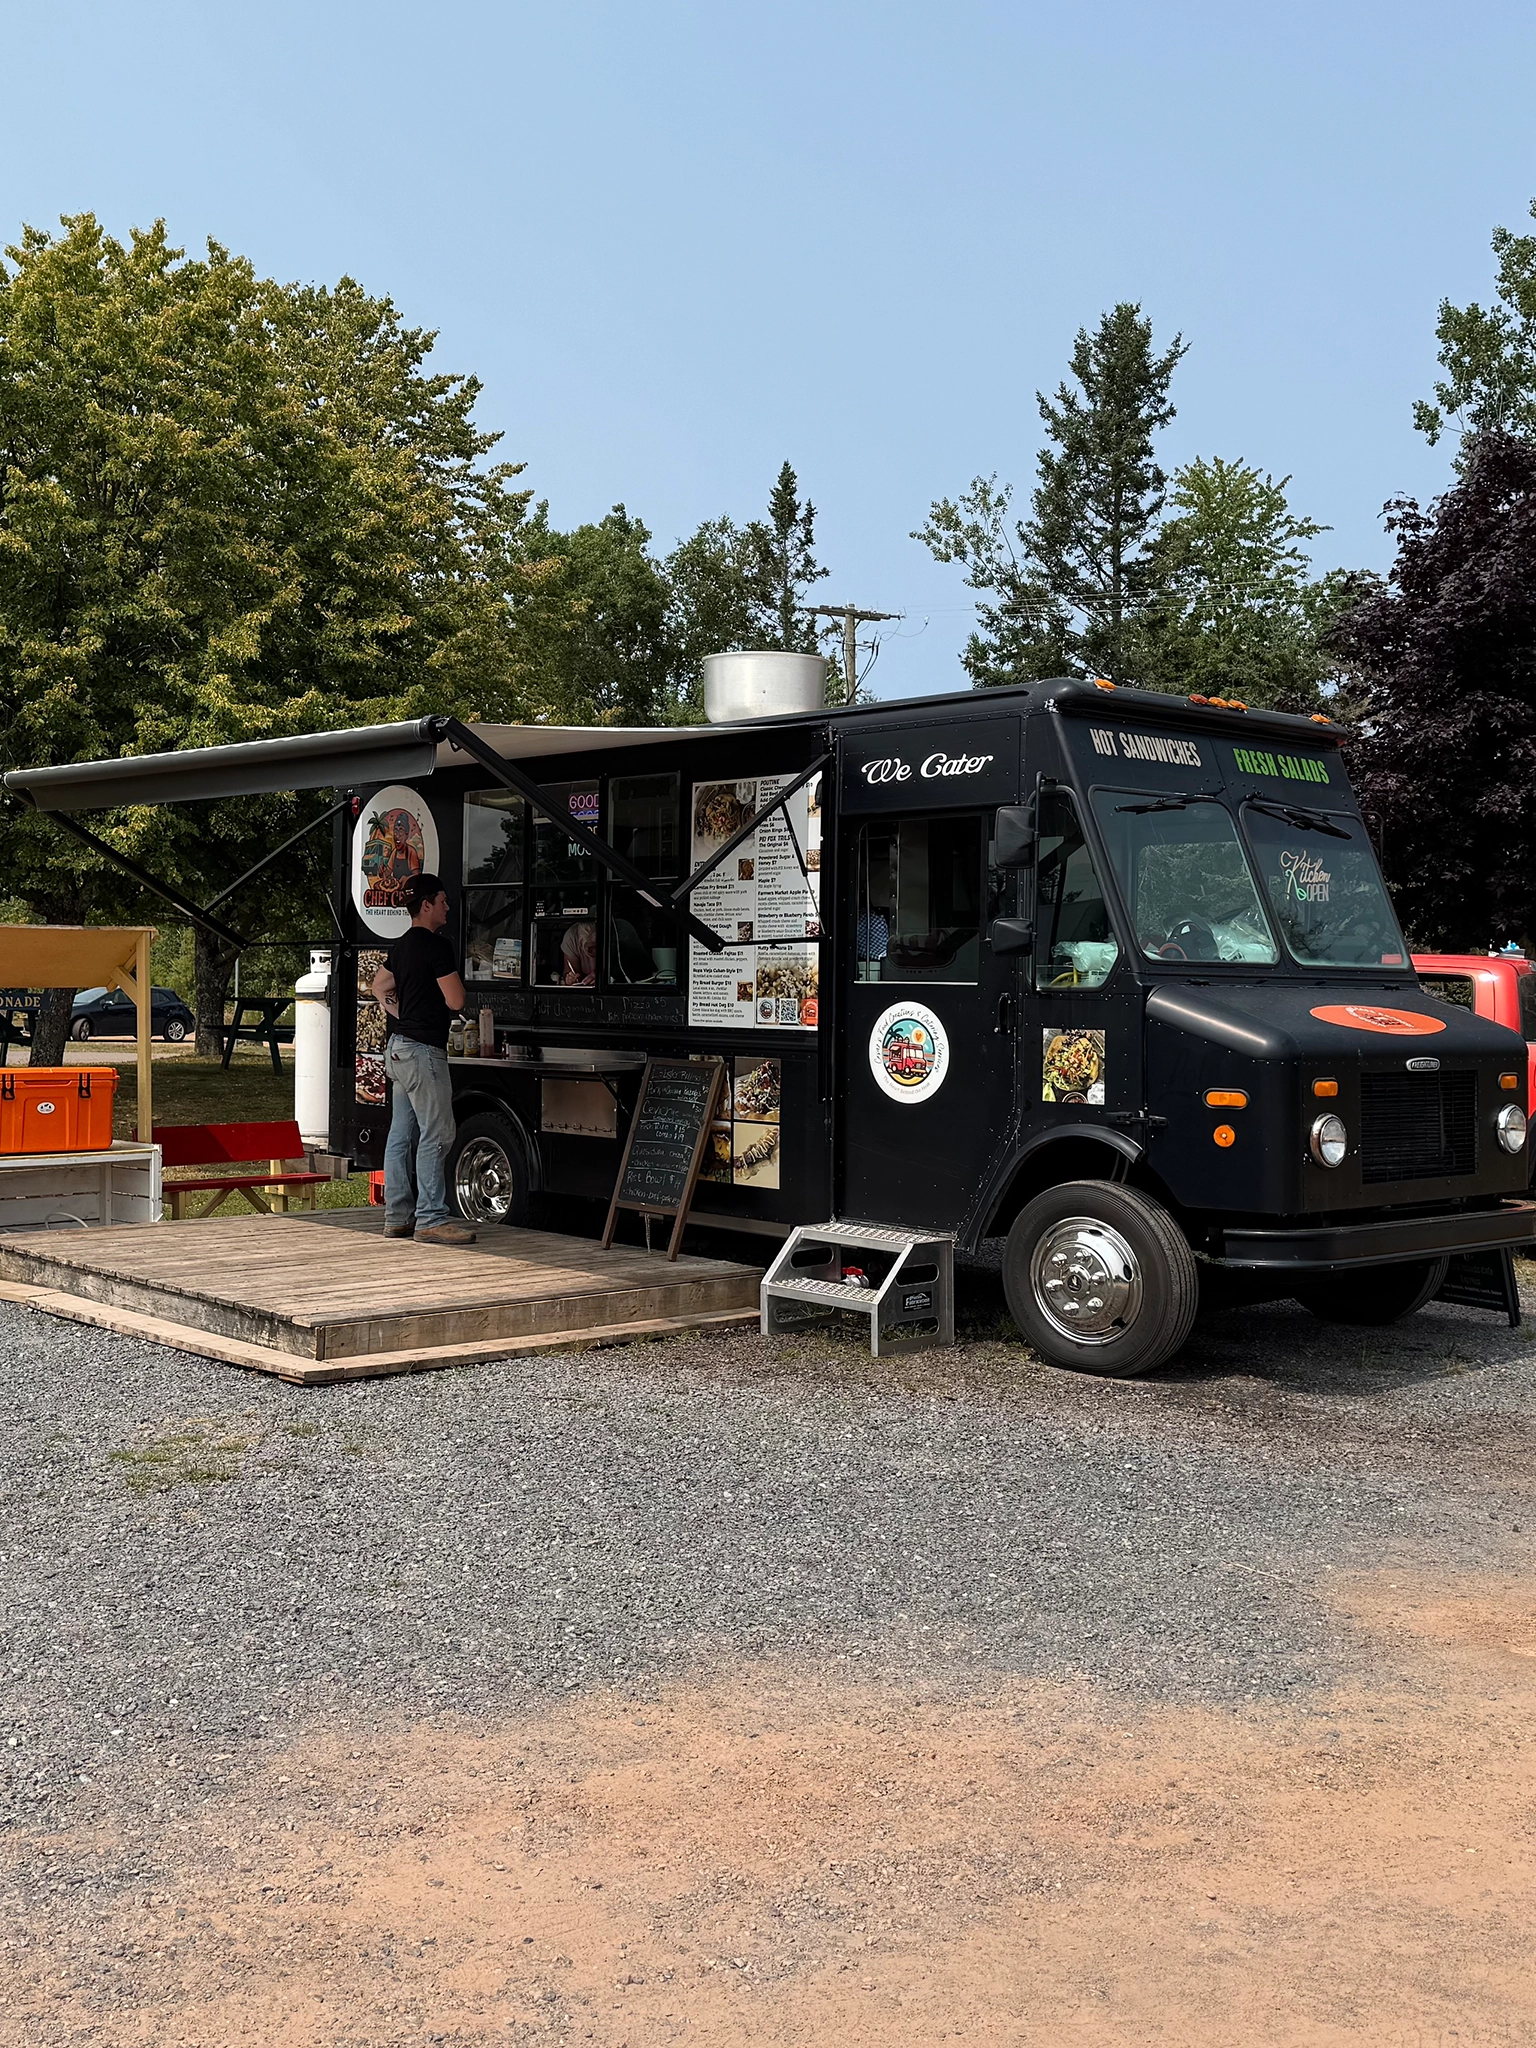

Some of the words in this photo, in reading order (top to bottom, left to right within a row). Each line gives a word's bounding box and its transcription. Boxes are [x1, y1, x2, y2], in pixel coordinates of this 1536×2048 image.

[1089, 728, 1118, 756] HOT
[1118, 731, 1202, 767] SANDWICHES
[861, 757, 913, 784] We
[920, 752, 993, 778] Cater
[1232, 748, 1279, 777] FRESH
[1277, 754, 1330, 784] SALADS
[569, 793, 599, 809] GOOD
[1280, 850, 1331, 900] Kitchen
[364, 890, 389, 907] CHEF
[1306, 883, 1329, 902] OPEN
[622, 996, 651, 1013] Pizza
[645, 1170, 667, 1186] Bowl
